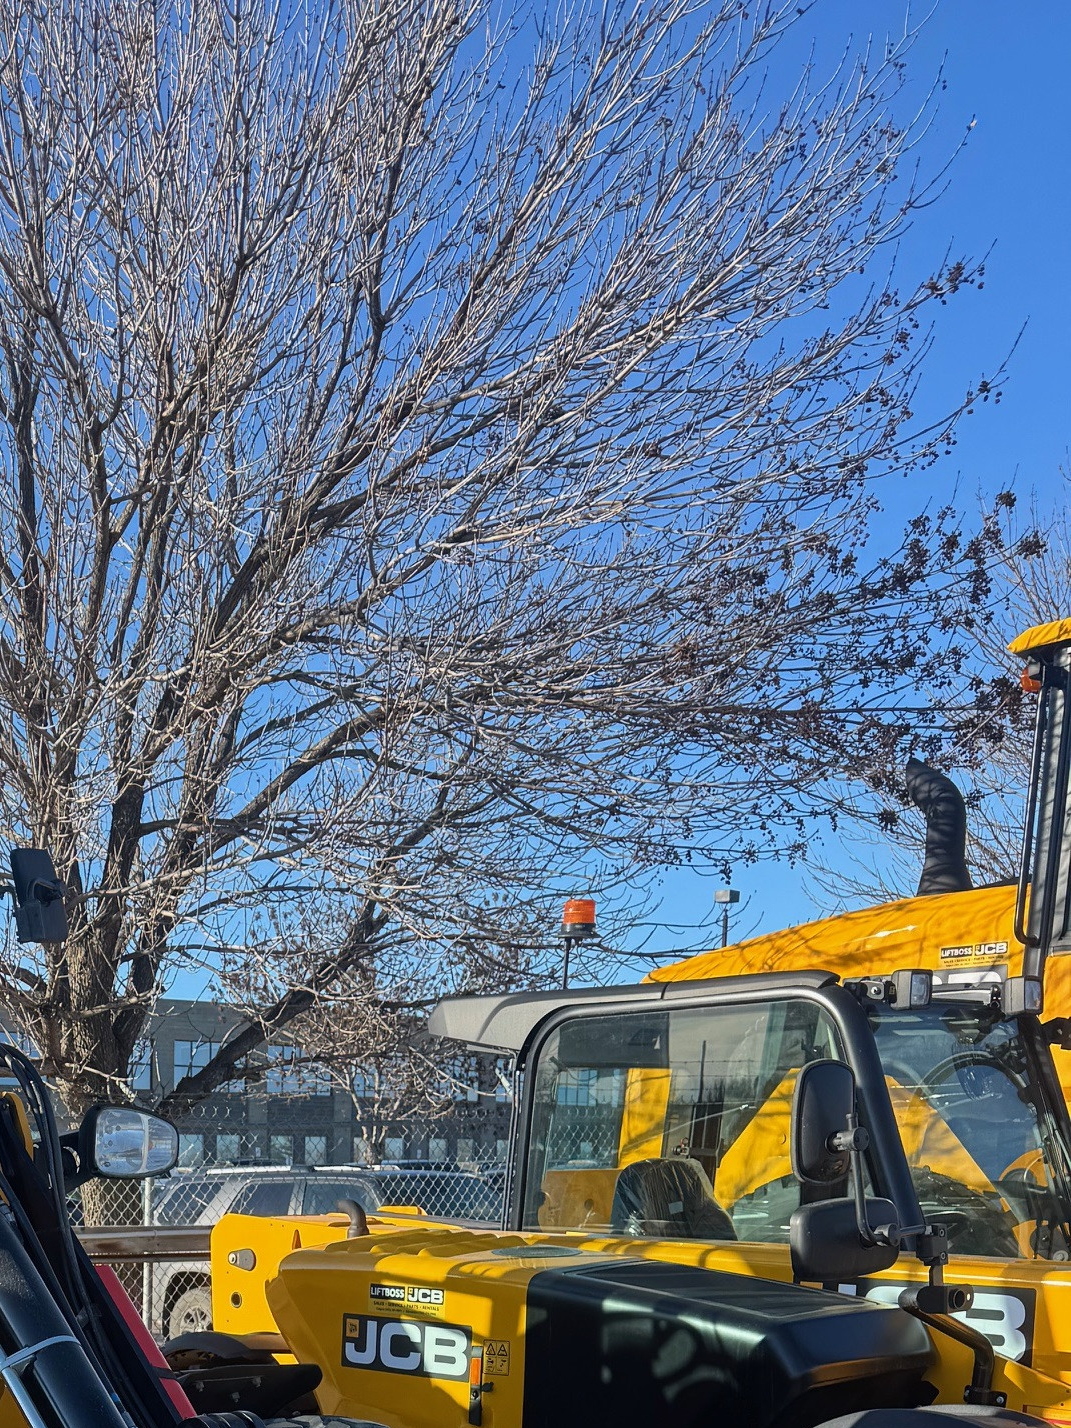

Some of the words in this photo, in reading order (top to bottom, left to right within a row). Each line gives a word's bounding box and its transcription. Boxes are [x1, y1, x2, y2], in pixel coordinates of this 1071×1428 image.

[941, 947, 973, 958] LIFTBOSS
[975, 942, 1007, 956] JCB
[370, 1286, 404, 1299] LIFTBOSS
[408, 1287, 444, 1304] JCB
[345, 1320, 468, 1376] JCB
